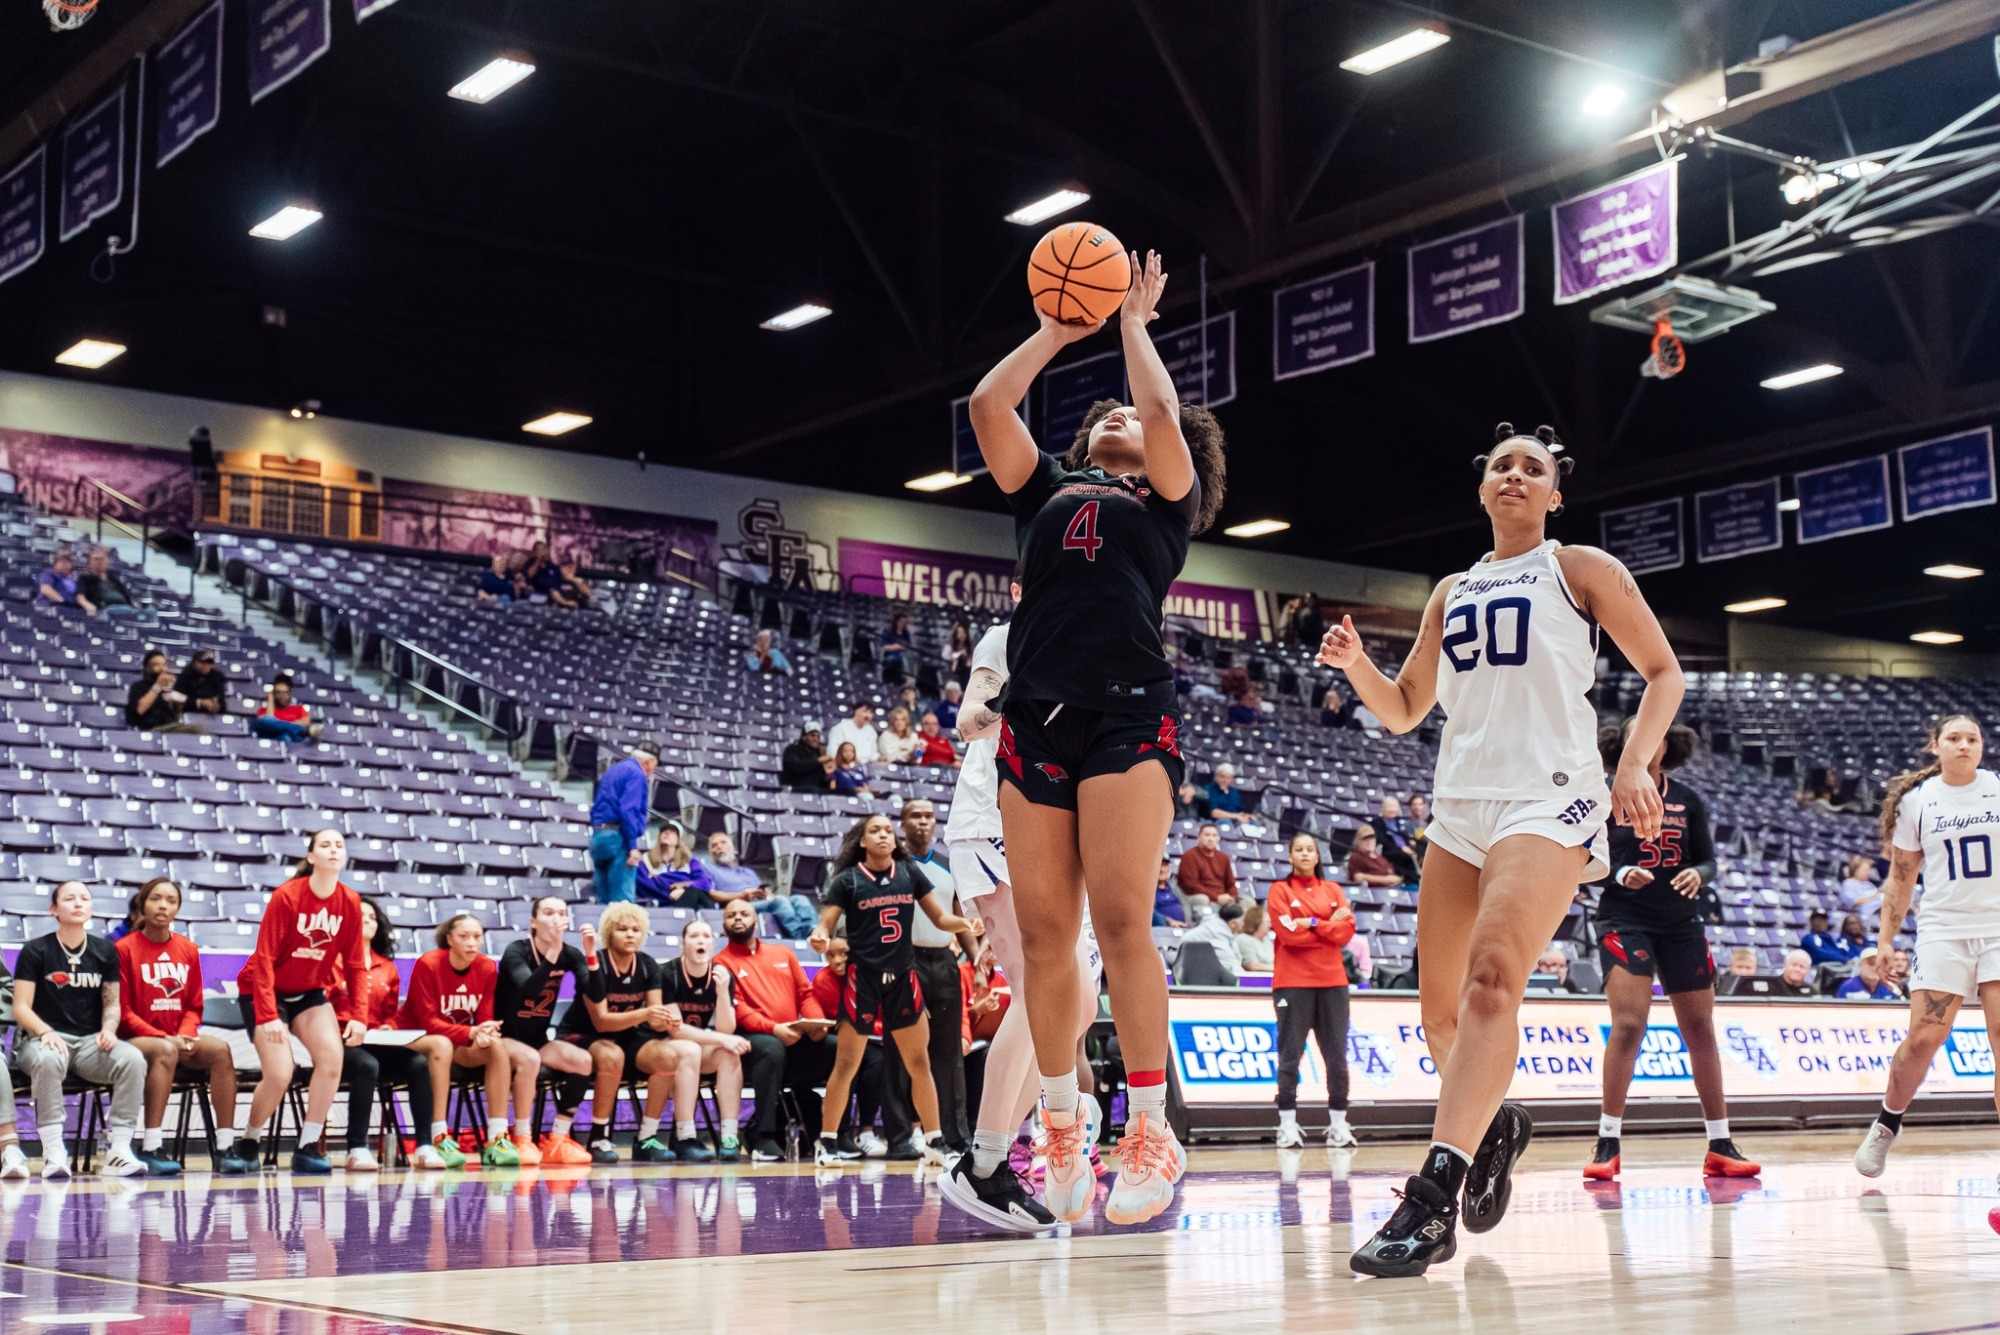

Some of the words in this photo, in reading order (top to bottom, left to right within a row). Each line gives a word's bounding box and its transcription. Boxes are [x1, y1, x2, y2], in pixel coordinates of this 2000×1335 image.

[1063, 501, 1103, 561] 4
[881, 559, 1013, 611] WELCOM
[1442, 597, 1531, 673] 20
[1931, 812, 2000, 834] Ladyjacks
[1638, 829, 1682, 868] 35
[1943, 834, 1992, 881] 10
[858, 893, 913, 910] CARDINALS
[880, 908, 902, 943] 5
[70, 972, 102, 988] UIW
[141, 962, 190, 985] UIW
[441, 994, 483, 1014] UIW
[1191, 1026, 1272, 1053] BUD
[1523, 1026, 1590, 1043] FANS
[1640, 1030, 1682, 1053] UD
[1779, 1028, 1823, 1044] FOR
[1830, 1028, 1872, 1044] THE
[1951, 1031, 1991, 1053] BU
[1798, 1055, 1832, 1072] ON
[1949, 1052, 1995, 1074] LIG
